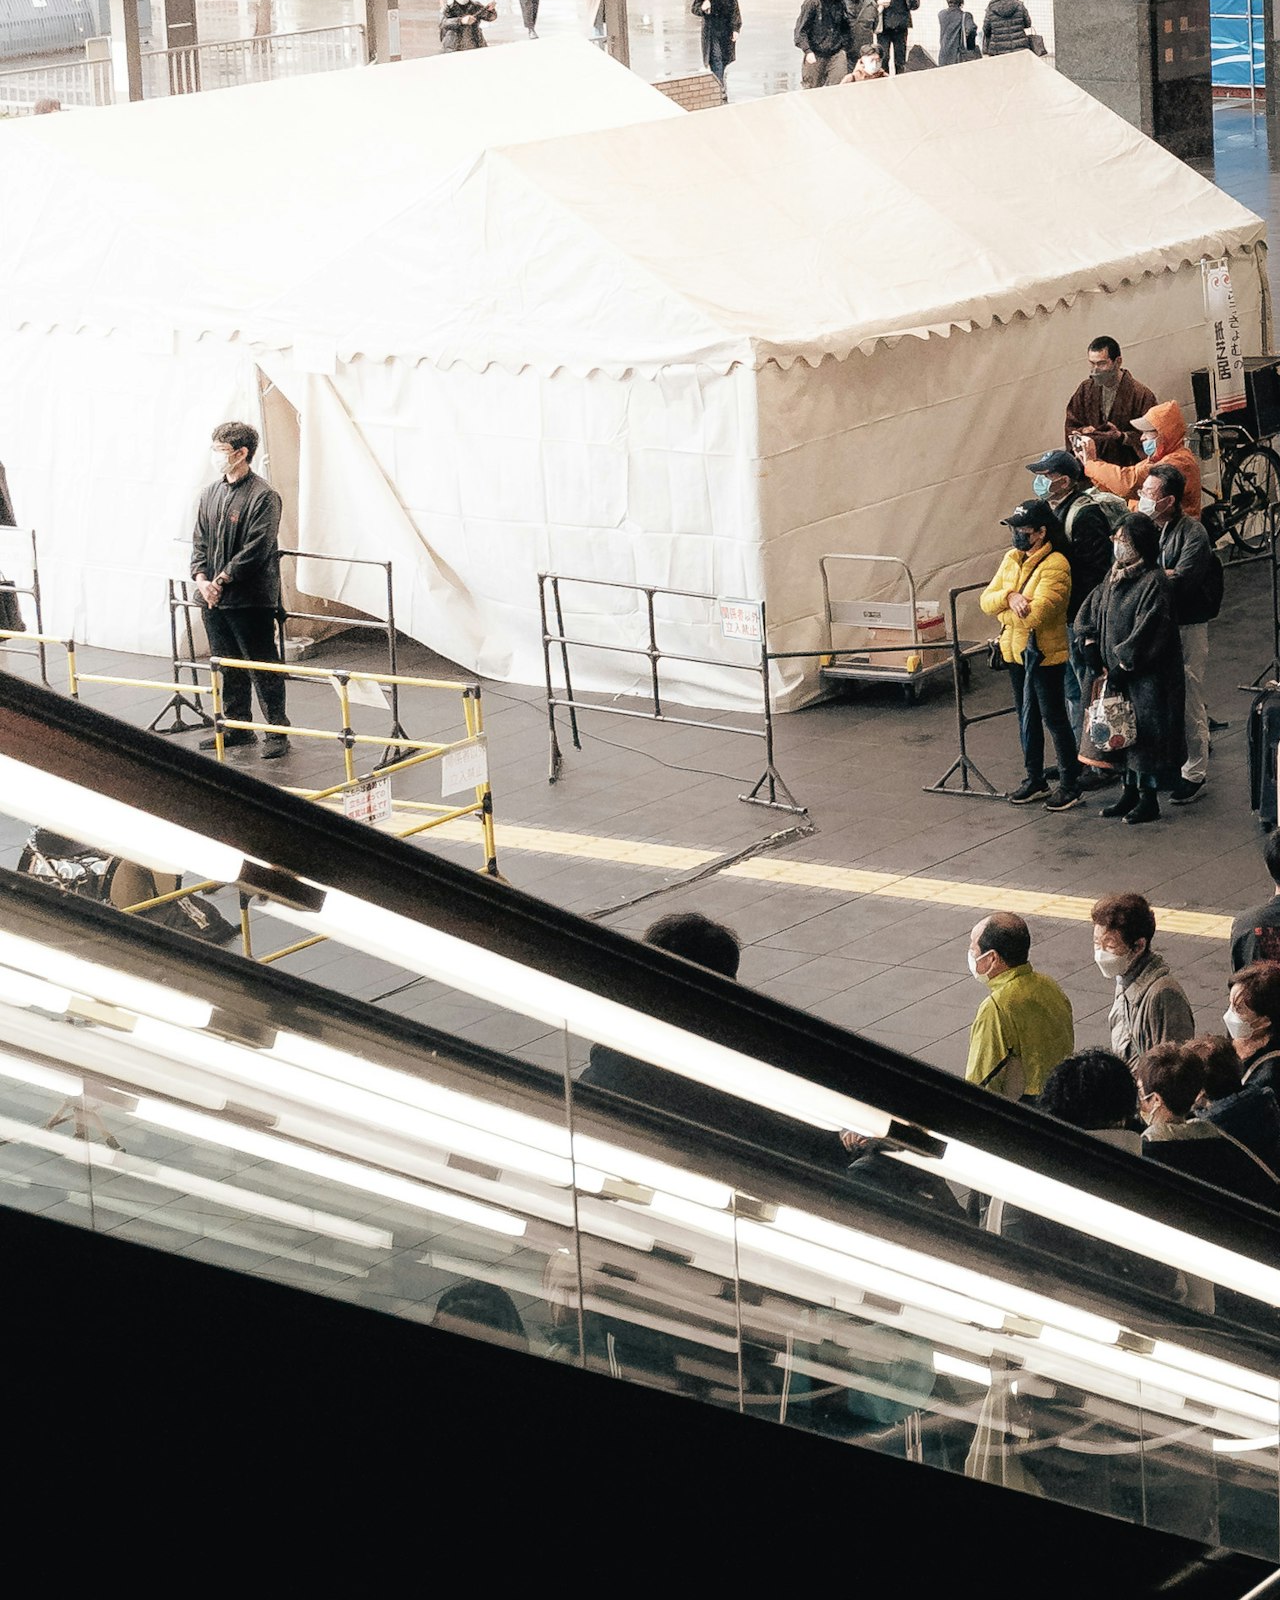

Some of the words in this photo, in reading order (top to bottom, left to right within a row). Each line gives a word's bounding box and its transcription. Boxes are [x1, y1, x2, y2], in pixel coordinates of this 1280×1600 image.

[1214, 320, 1232, 381] 紙芝居
[725, 622, 759, 637] 立入禁止
